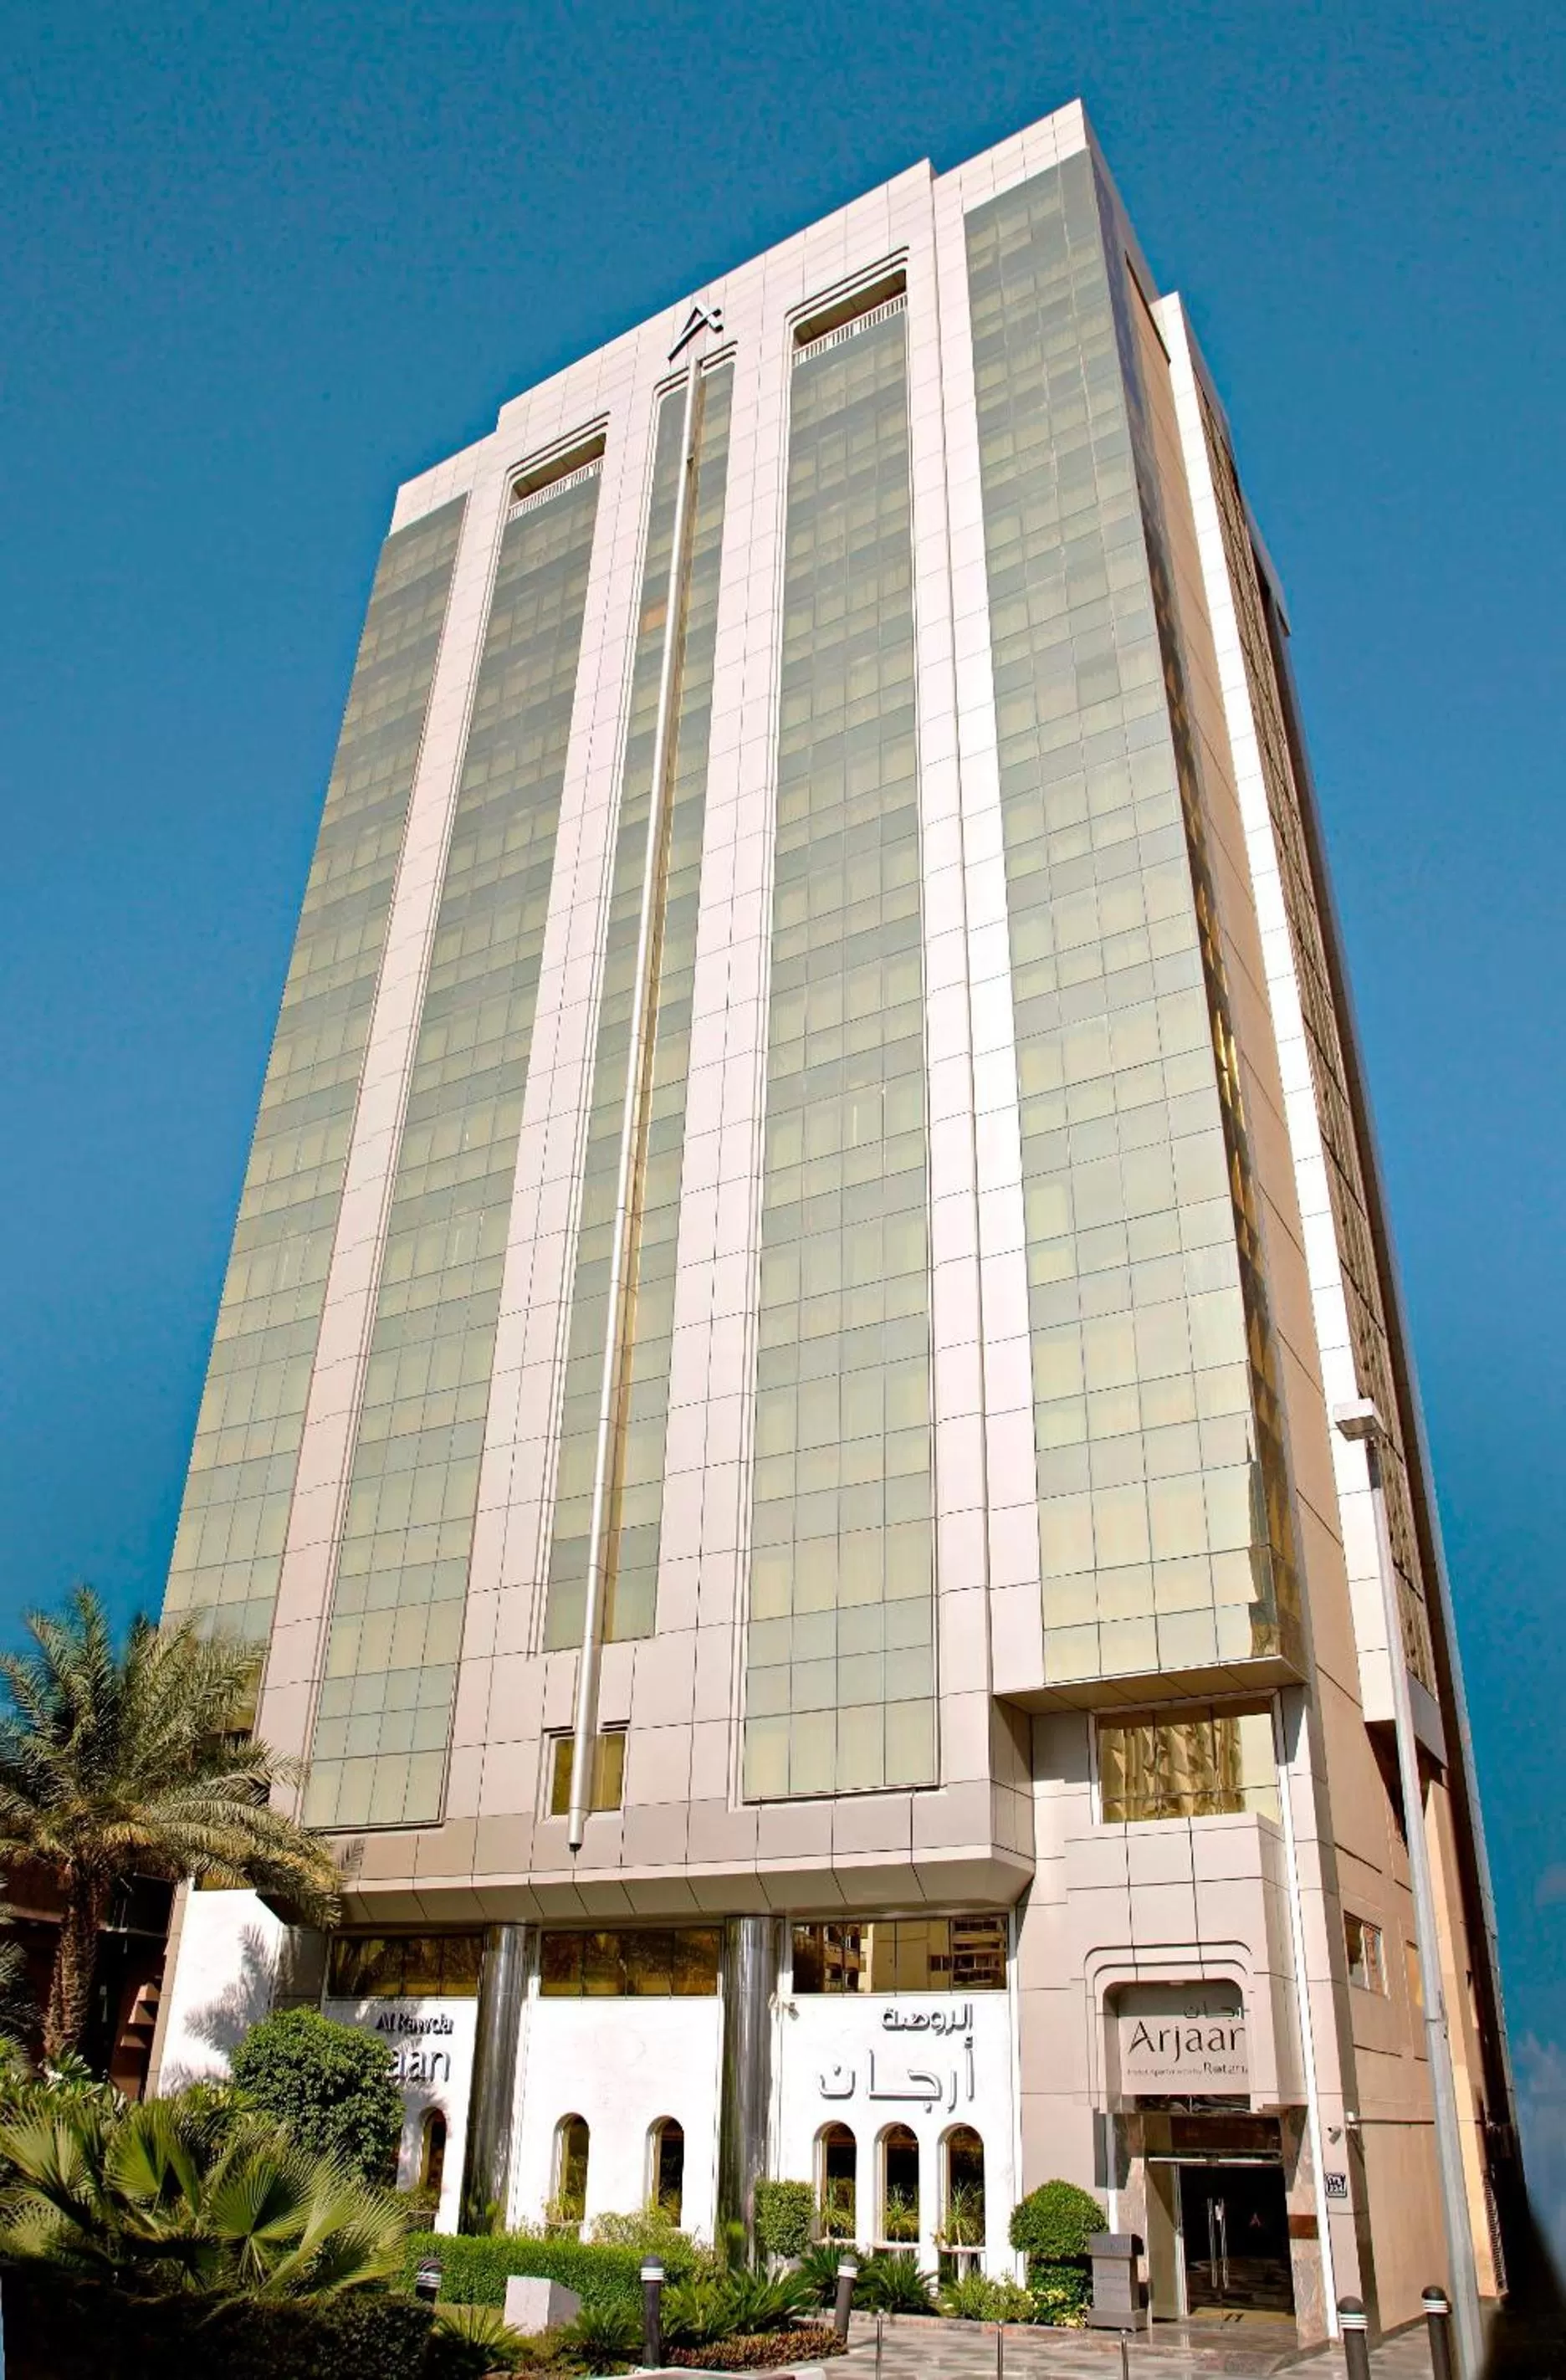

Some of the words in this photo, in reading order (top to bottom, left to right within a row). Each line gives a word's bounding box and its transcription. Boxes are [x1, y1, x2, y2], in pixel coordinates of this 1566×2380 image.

[376, 2012, 396, 2032] Al
[397, 2012, 454, 2035] Rawda
[386, 2050, 452, 2083] aan
[819, 2035, 975, 2114] أرجان
